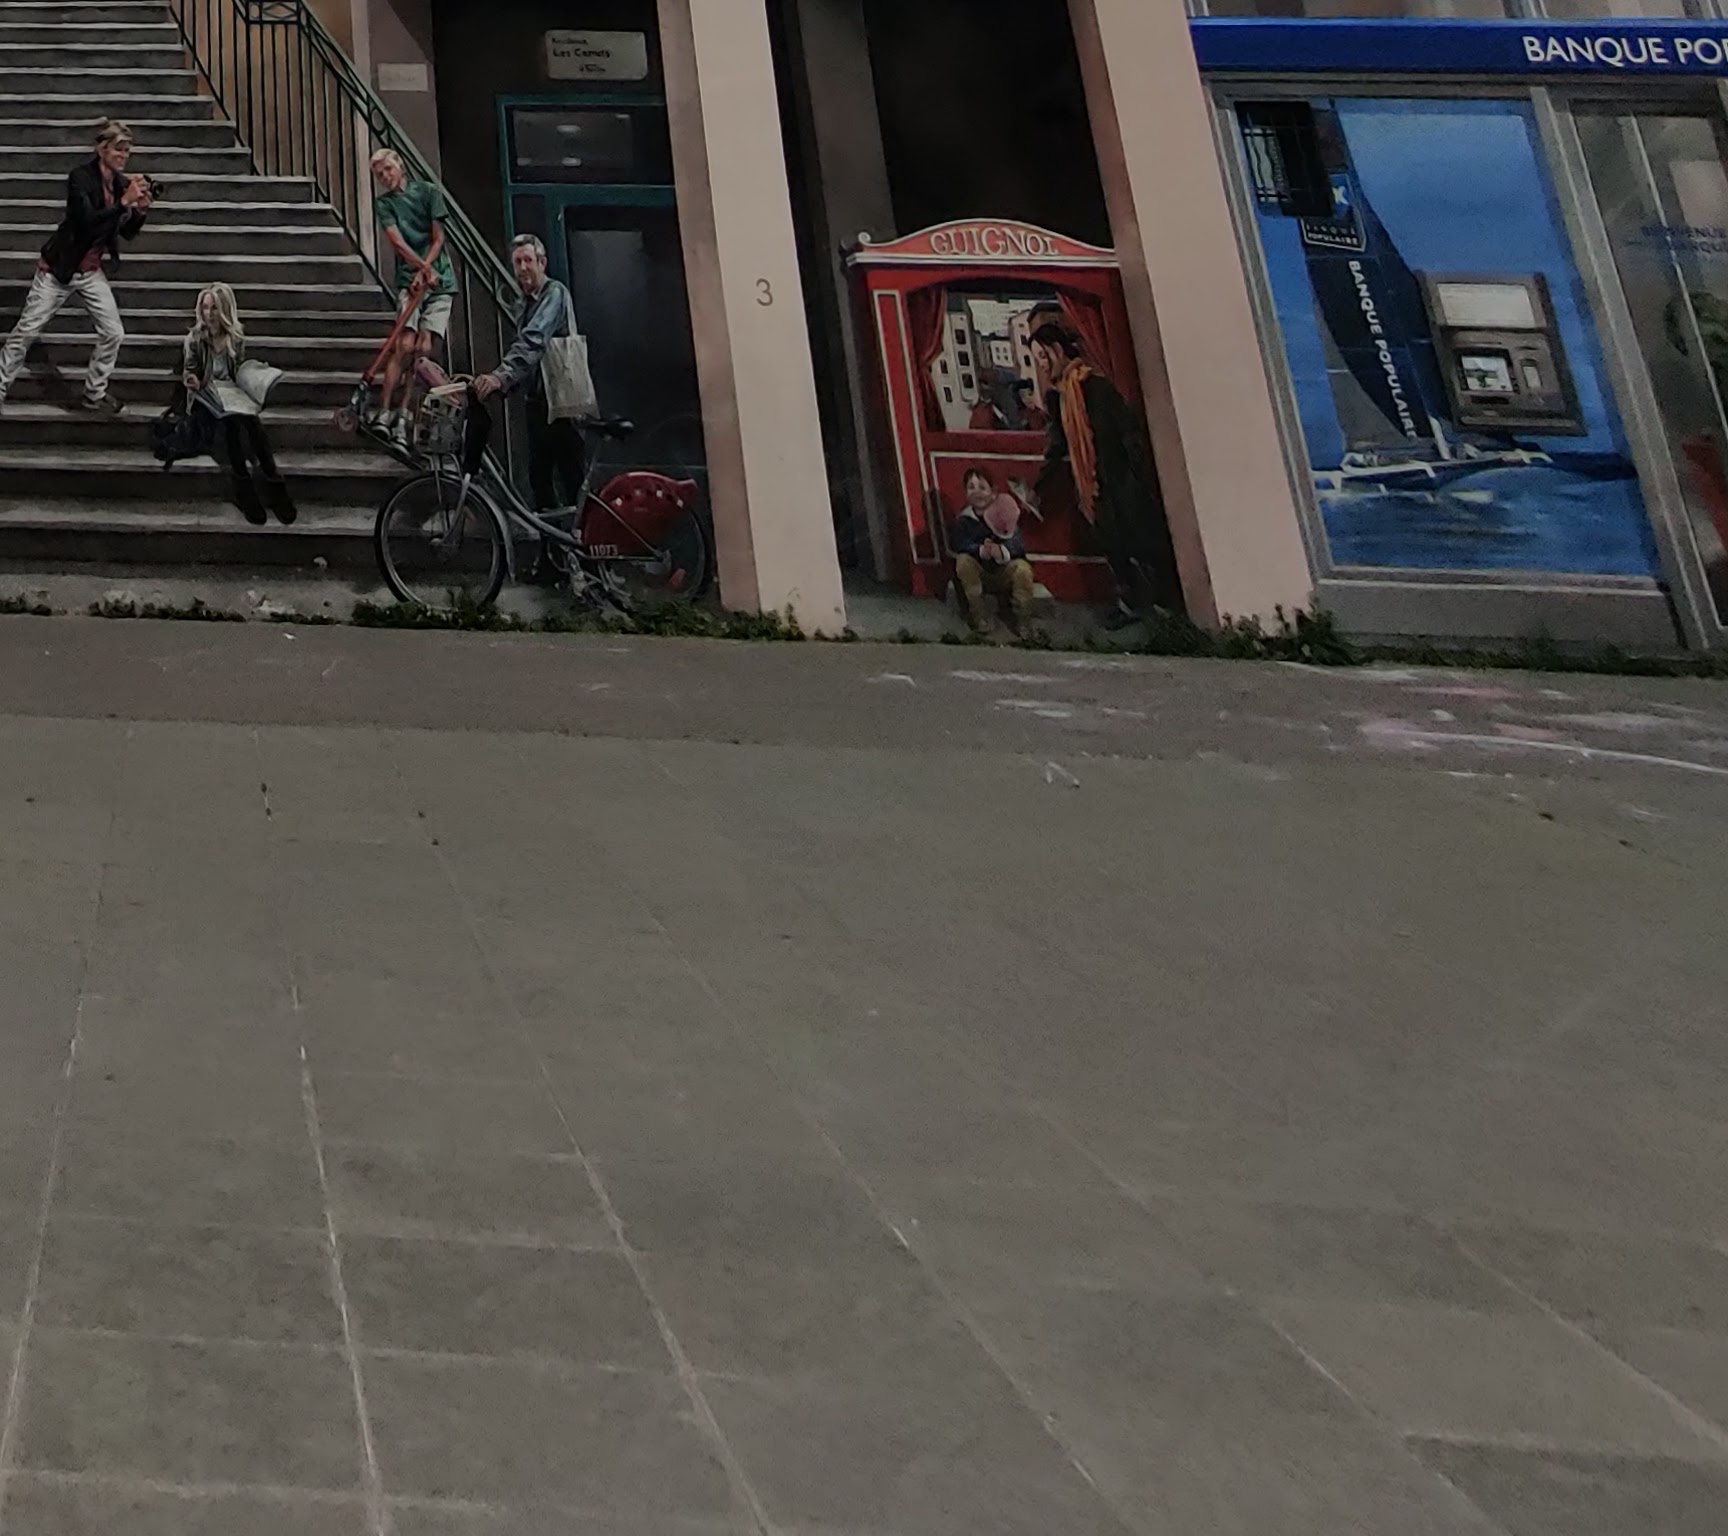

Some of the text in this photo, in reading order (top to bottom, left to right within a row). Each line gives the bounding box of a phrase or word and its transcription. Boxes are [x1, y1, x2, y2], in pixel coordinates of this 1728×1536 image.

[1522, 35, 1670, 68] BANQUE
[930, 226, 1059, 257] GUIGNOL
[756, 278, 773, 306] 3
[1348, 259, 1384, 335] BANQUE
